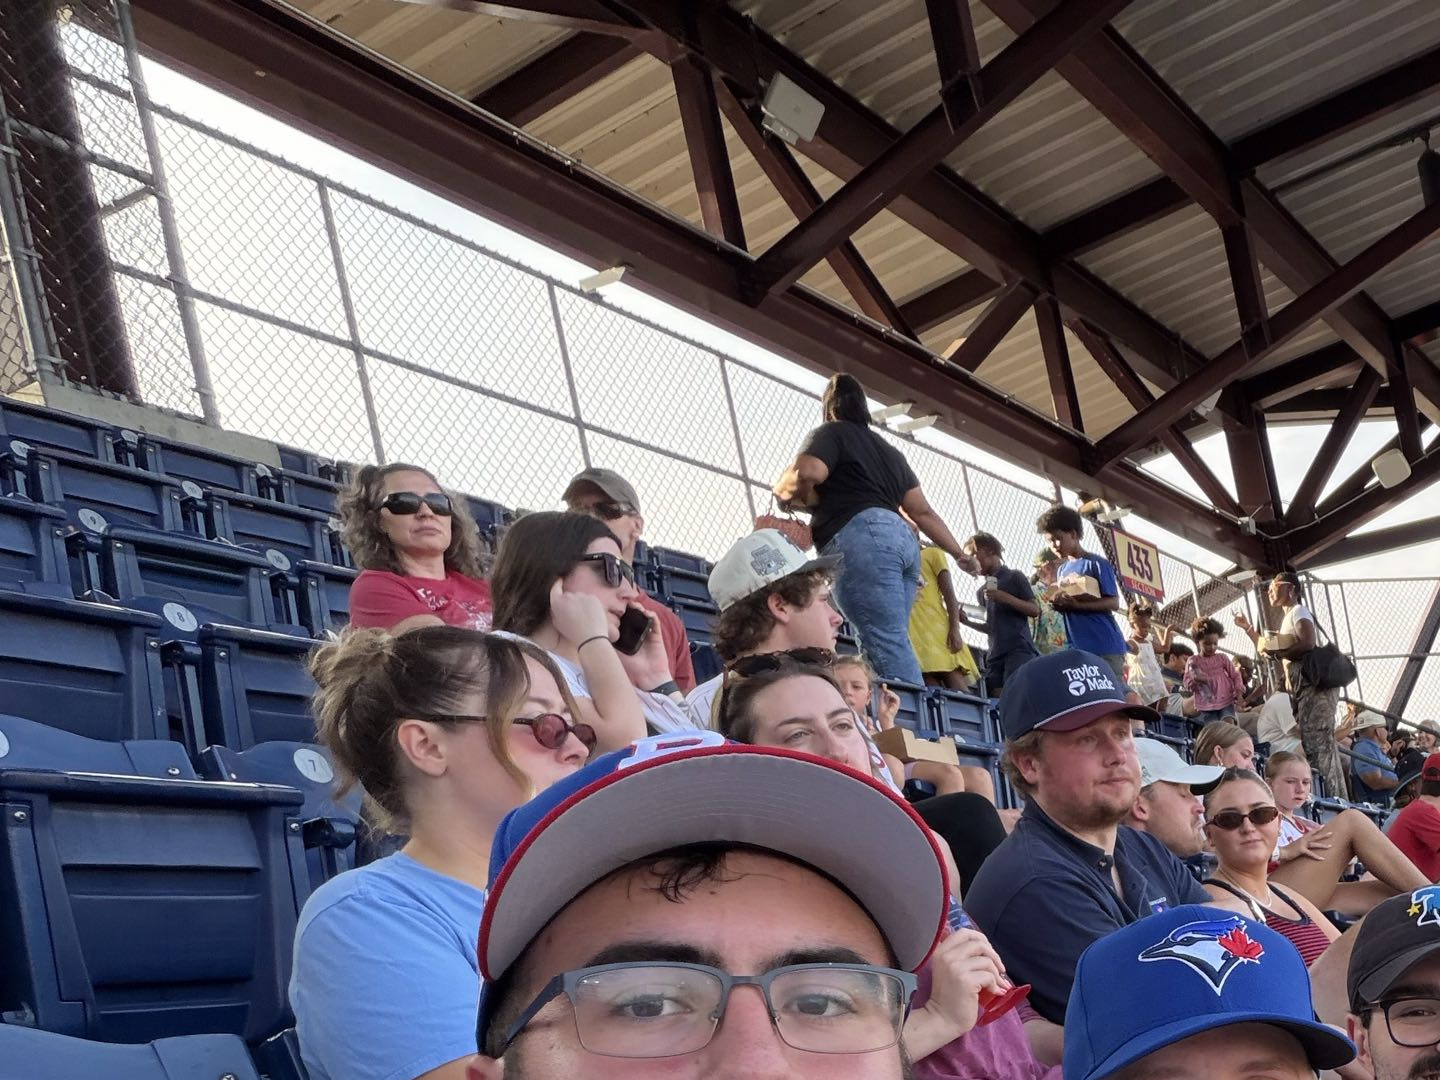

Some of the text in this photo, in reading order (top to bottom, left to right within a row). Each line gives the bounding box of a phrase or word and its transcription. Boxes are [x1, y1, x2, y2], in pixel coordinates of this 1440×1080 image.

[1127, 541, 1153, 582] 433
[1131, 578, 1157, 596] SECTION
[1062, 663, 1101, 681] Taylor
[1086, 674, 1116, 691] Made
[308, 758, 318, 772] 7
